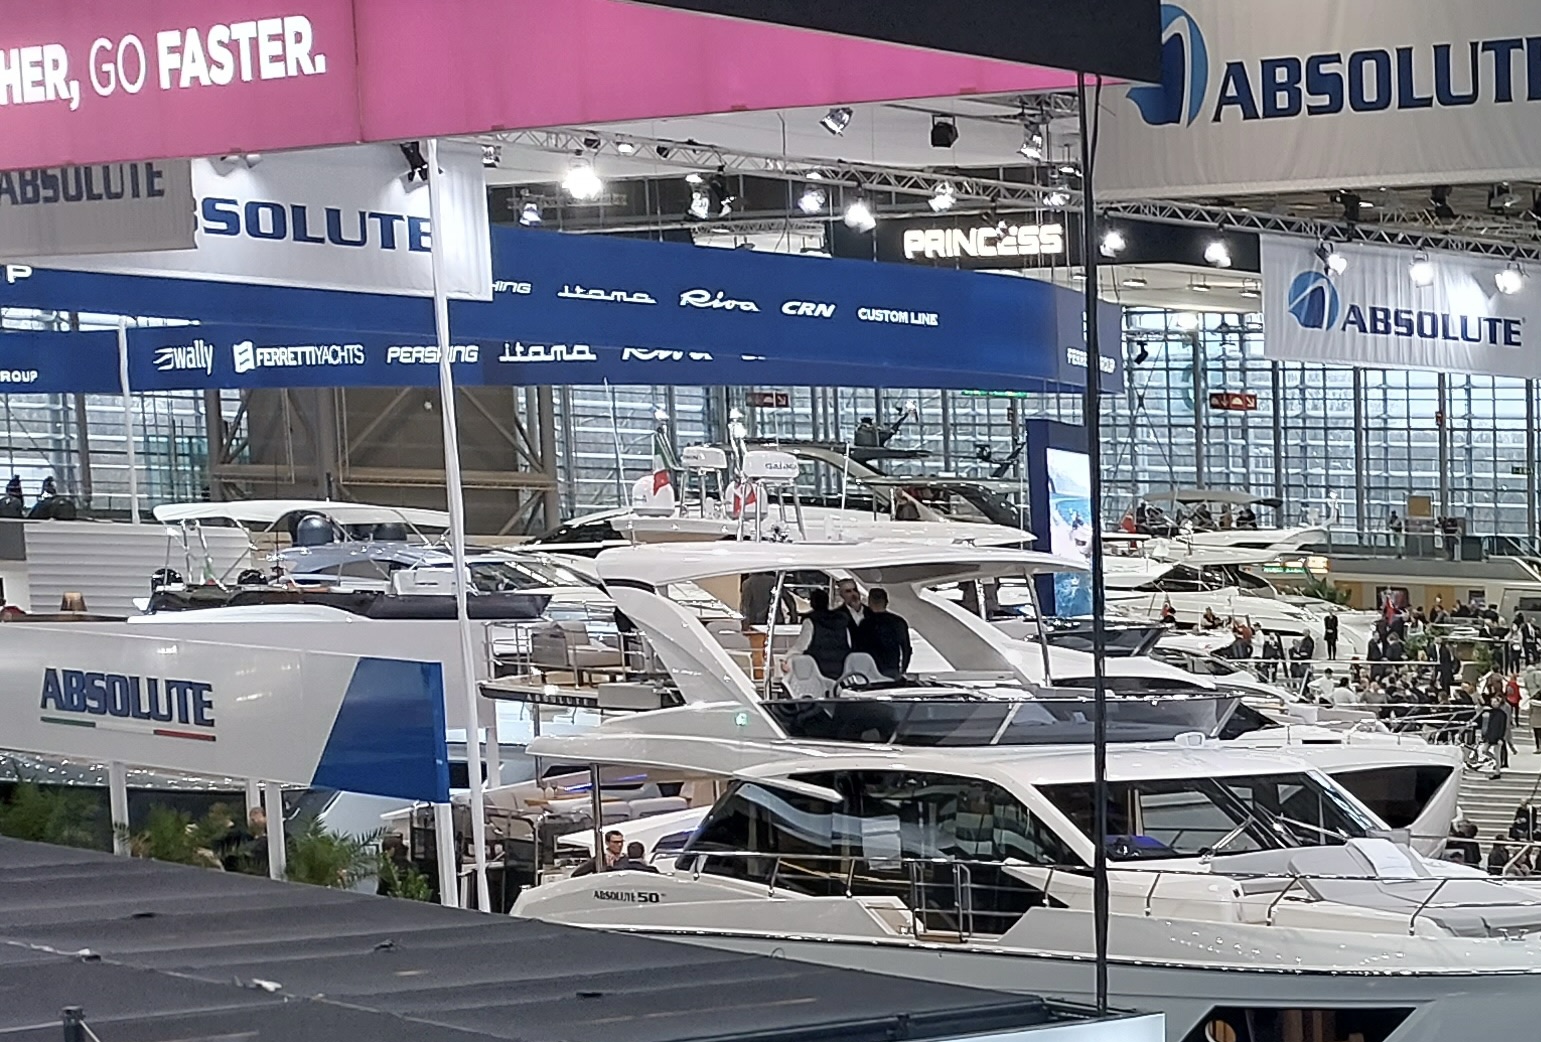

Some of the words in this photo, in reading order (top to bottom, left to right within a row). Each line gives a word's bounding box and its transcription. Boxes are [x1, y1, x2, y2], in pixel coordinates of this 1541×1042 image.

[89, 34, 146, 96] GO
[157, 15, 326, 90] FASTER.
[194, 197, 432, 253] SOLUTE
[903, 224, 1063, 260] PRINCESS
[680, 290, 760, 313] Riva
[782, 302, 837, 319] CRN
[858, 307, 909, 325] CUSTOM
[911, 312, 939, 327] LINE
[1341, 304, 1522, 347] ABSOLUTE
[173, 340, 214, 375] wally
[0, 370, 38, 383] ROUP
[41, 667, 216, 728] ABSOLUTE
[637, 891, 661, 903] 50
